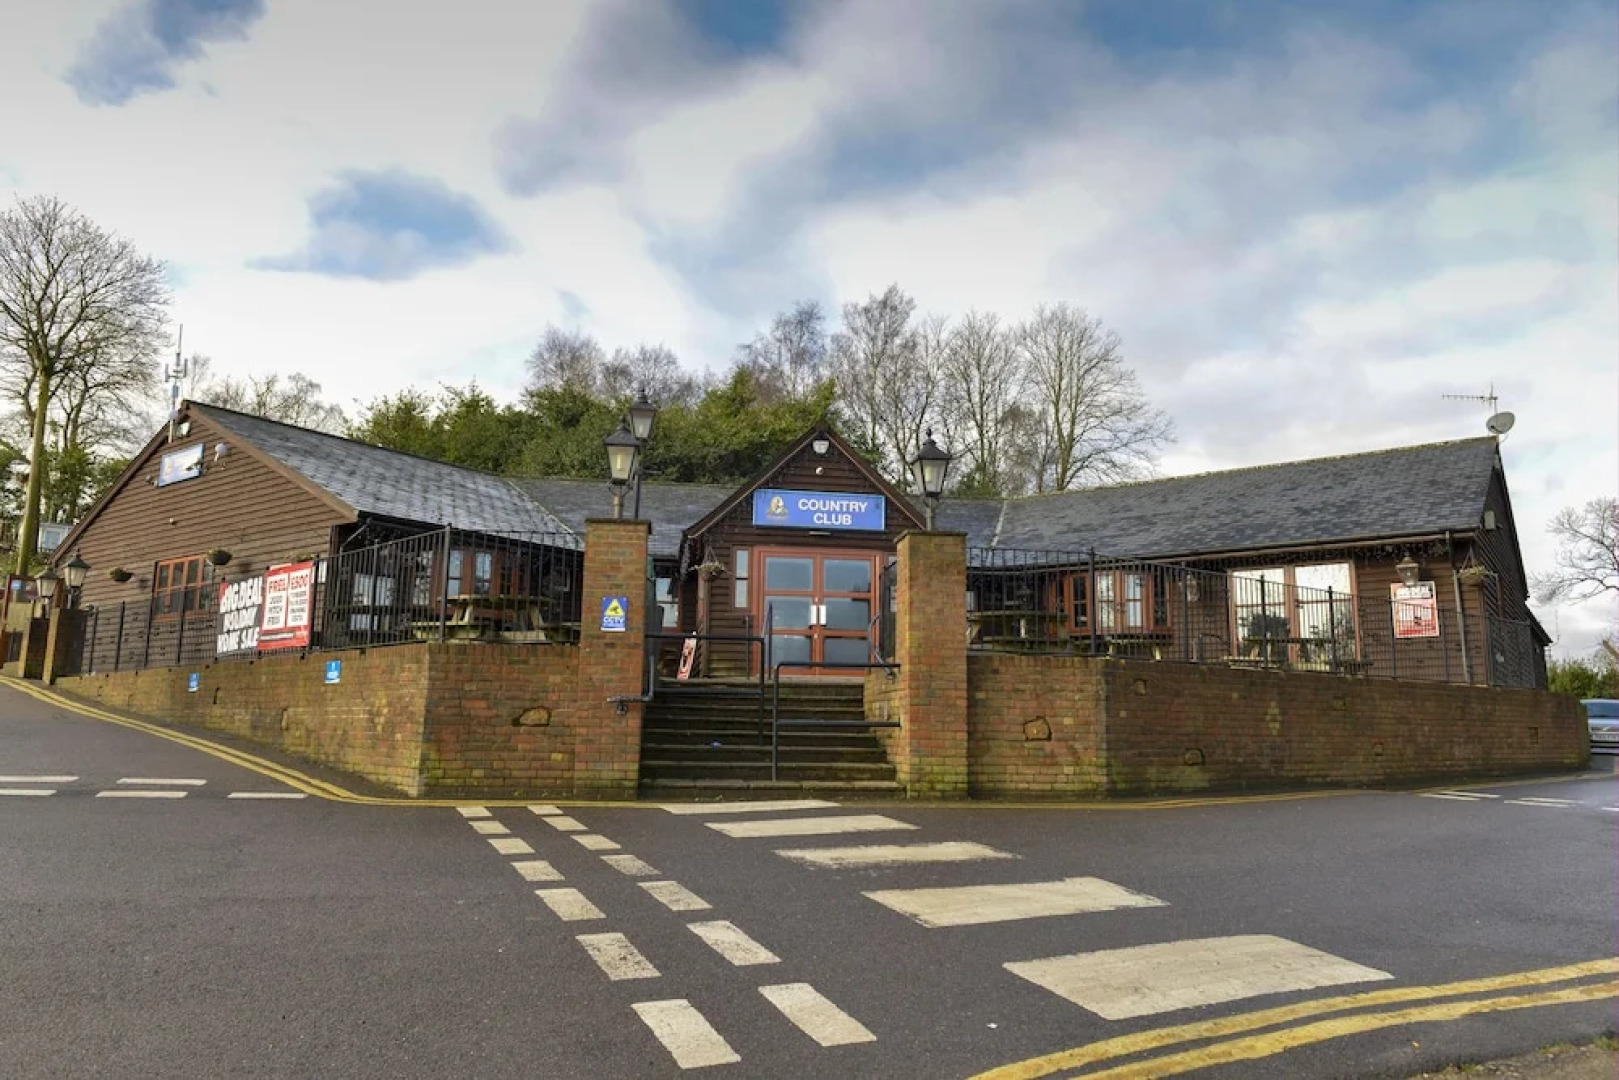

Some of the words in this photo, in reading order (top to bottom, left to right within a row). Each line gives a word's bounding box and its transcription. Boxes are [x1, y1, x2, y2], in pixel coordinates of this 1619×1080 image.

[798, 499, 868, 512] COUNTRY
[813, 513, 852, 525] CLUB
[238, 576, 262, 608] DEAL
[217, 631, 240, 654] HOME
